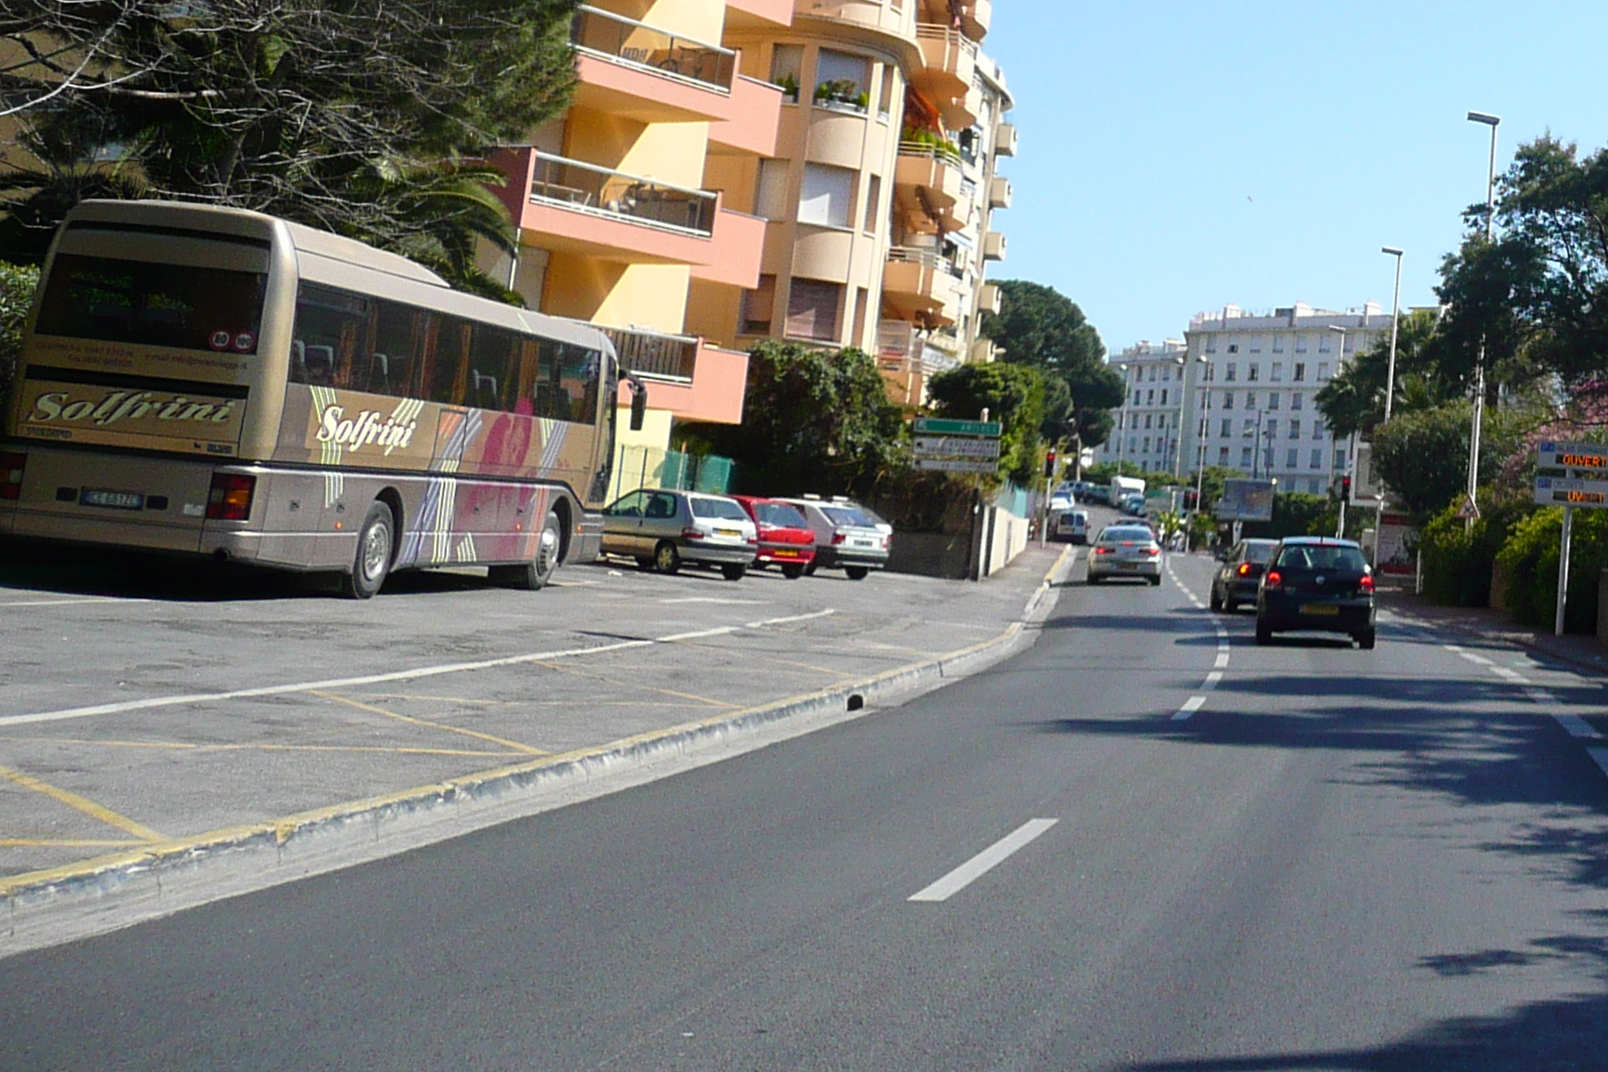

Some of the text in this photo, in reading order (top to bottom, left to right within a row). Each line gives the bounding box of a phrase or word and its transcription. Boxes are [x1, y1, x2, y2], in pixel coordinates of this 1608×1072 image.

[214, 333, 227, 345] 80
[237, 336, 252, 346] 100
[27, 391, 236, 426] Solfrini
[316, 405, 416, 452] Solfrini
[1563, 454, 1608, 467] OUVERT
